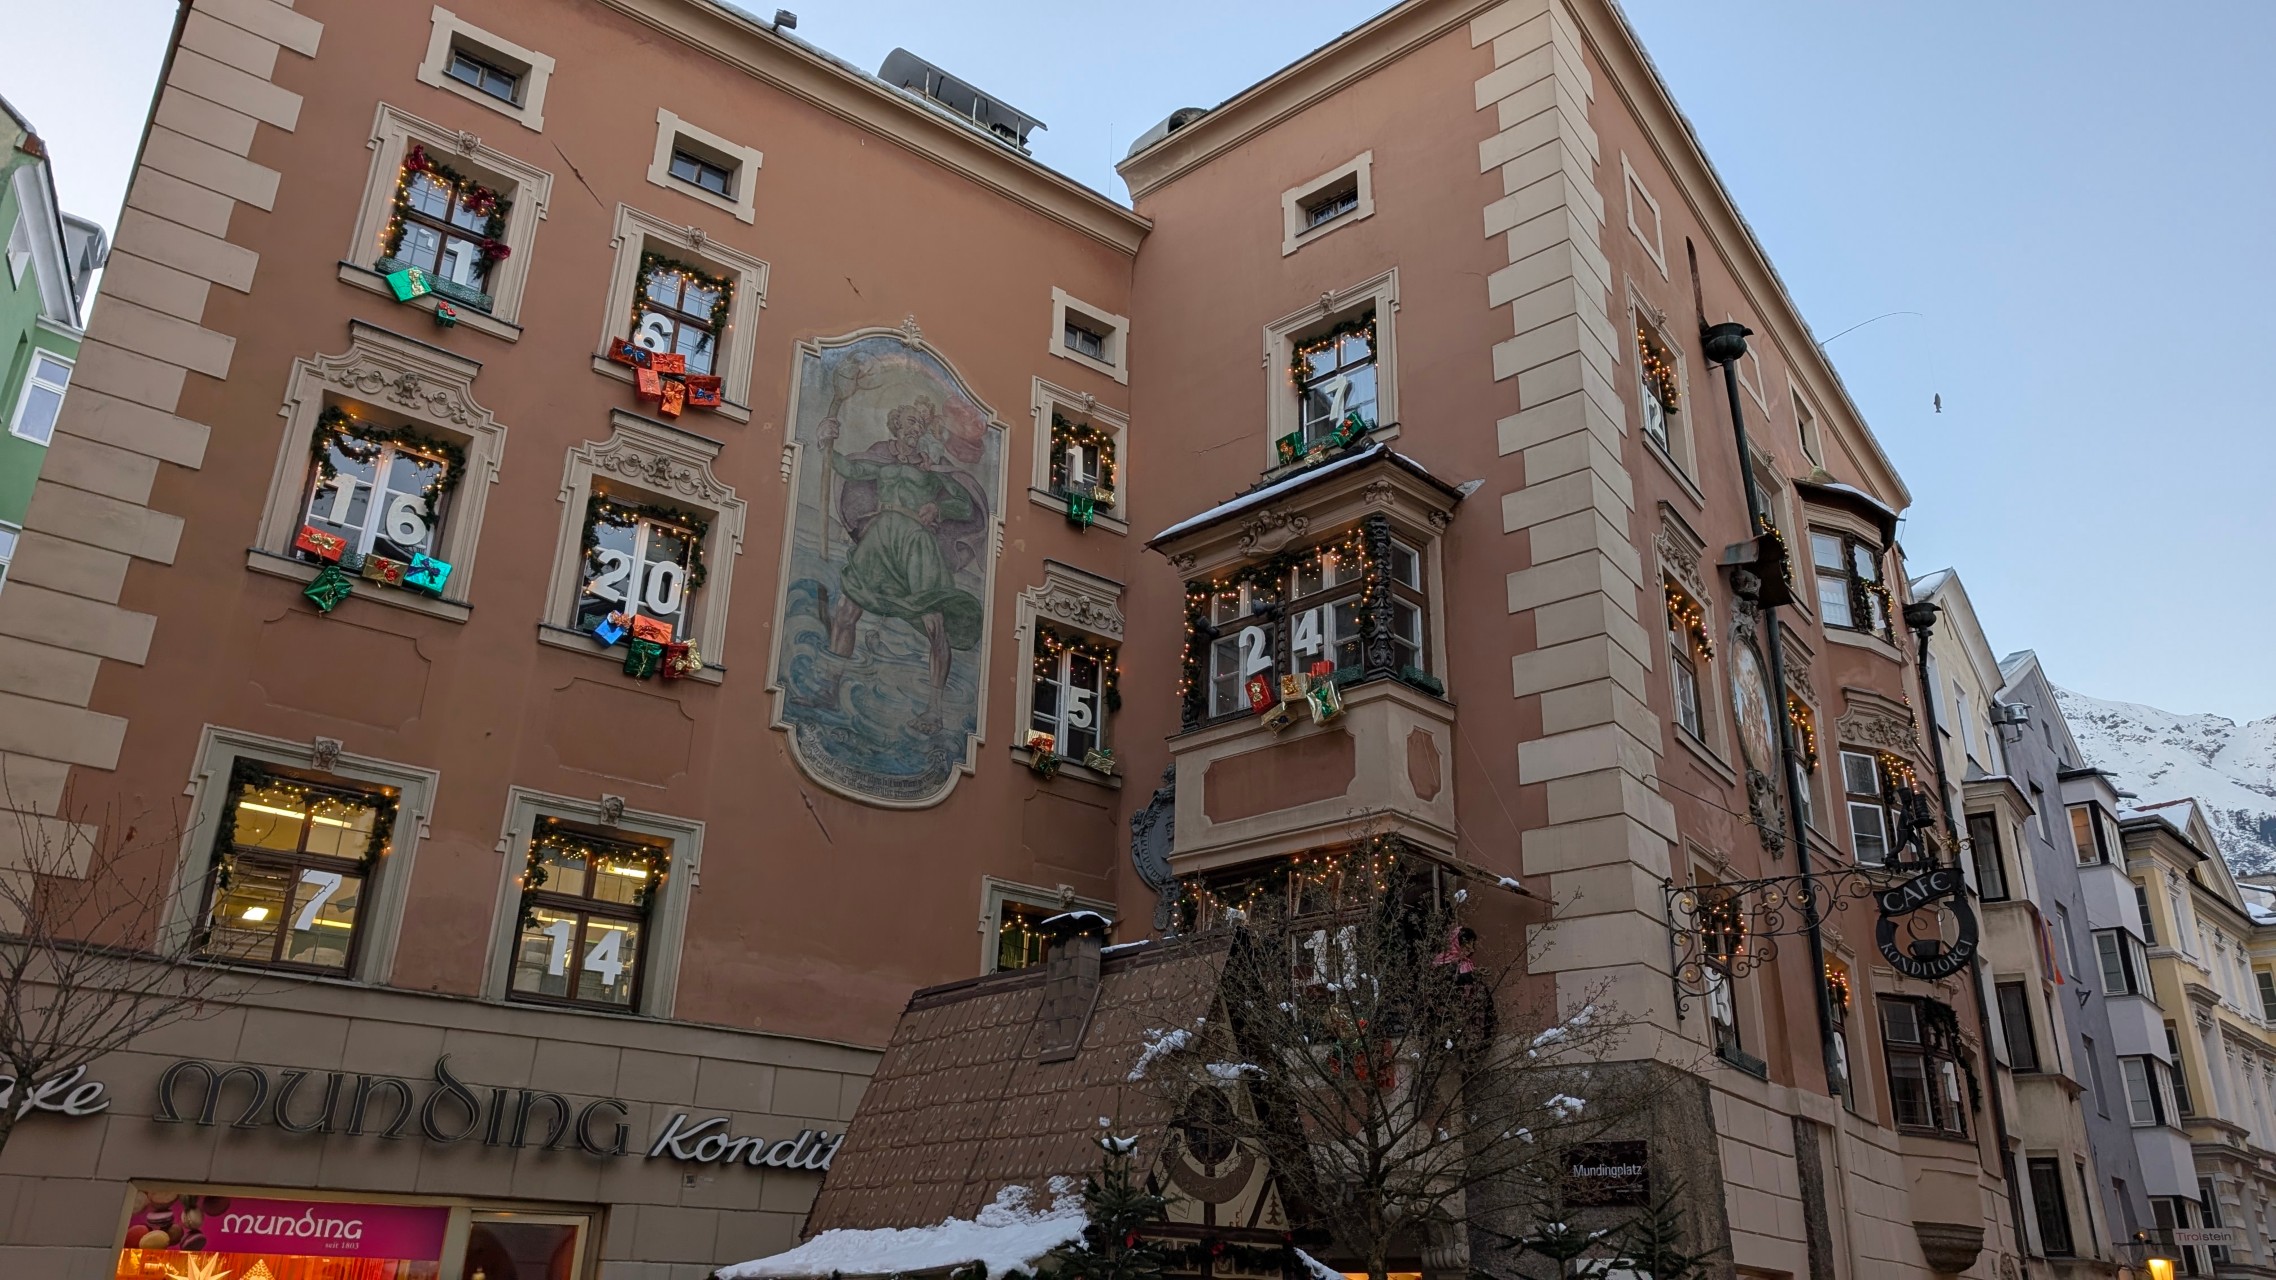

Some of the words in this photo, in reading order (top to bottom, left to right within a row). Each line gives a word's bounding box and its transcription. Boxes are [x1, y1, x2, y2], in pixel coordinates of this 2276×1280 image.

[634, 313, 673, 353] 6
[323, 473, 428, 545] 16
[588, 549, 684, 615] 20
[1239, 609, 1323, 676] 24
[1069, 687, 1092, 728] 5
[294, 869, 342, 931] 7
[1883, 872, 1951, 911] CAFE
[544, 919, 623, 985] 14
[1881, 940, 1973, 976] KONDITOREI
[1573, 1163, 1642, 1178] Mundingplatz
[2176, 1232, 2231, 1241] Tirolstein
